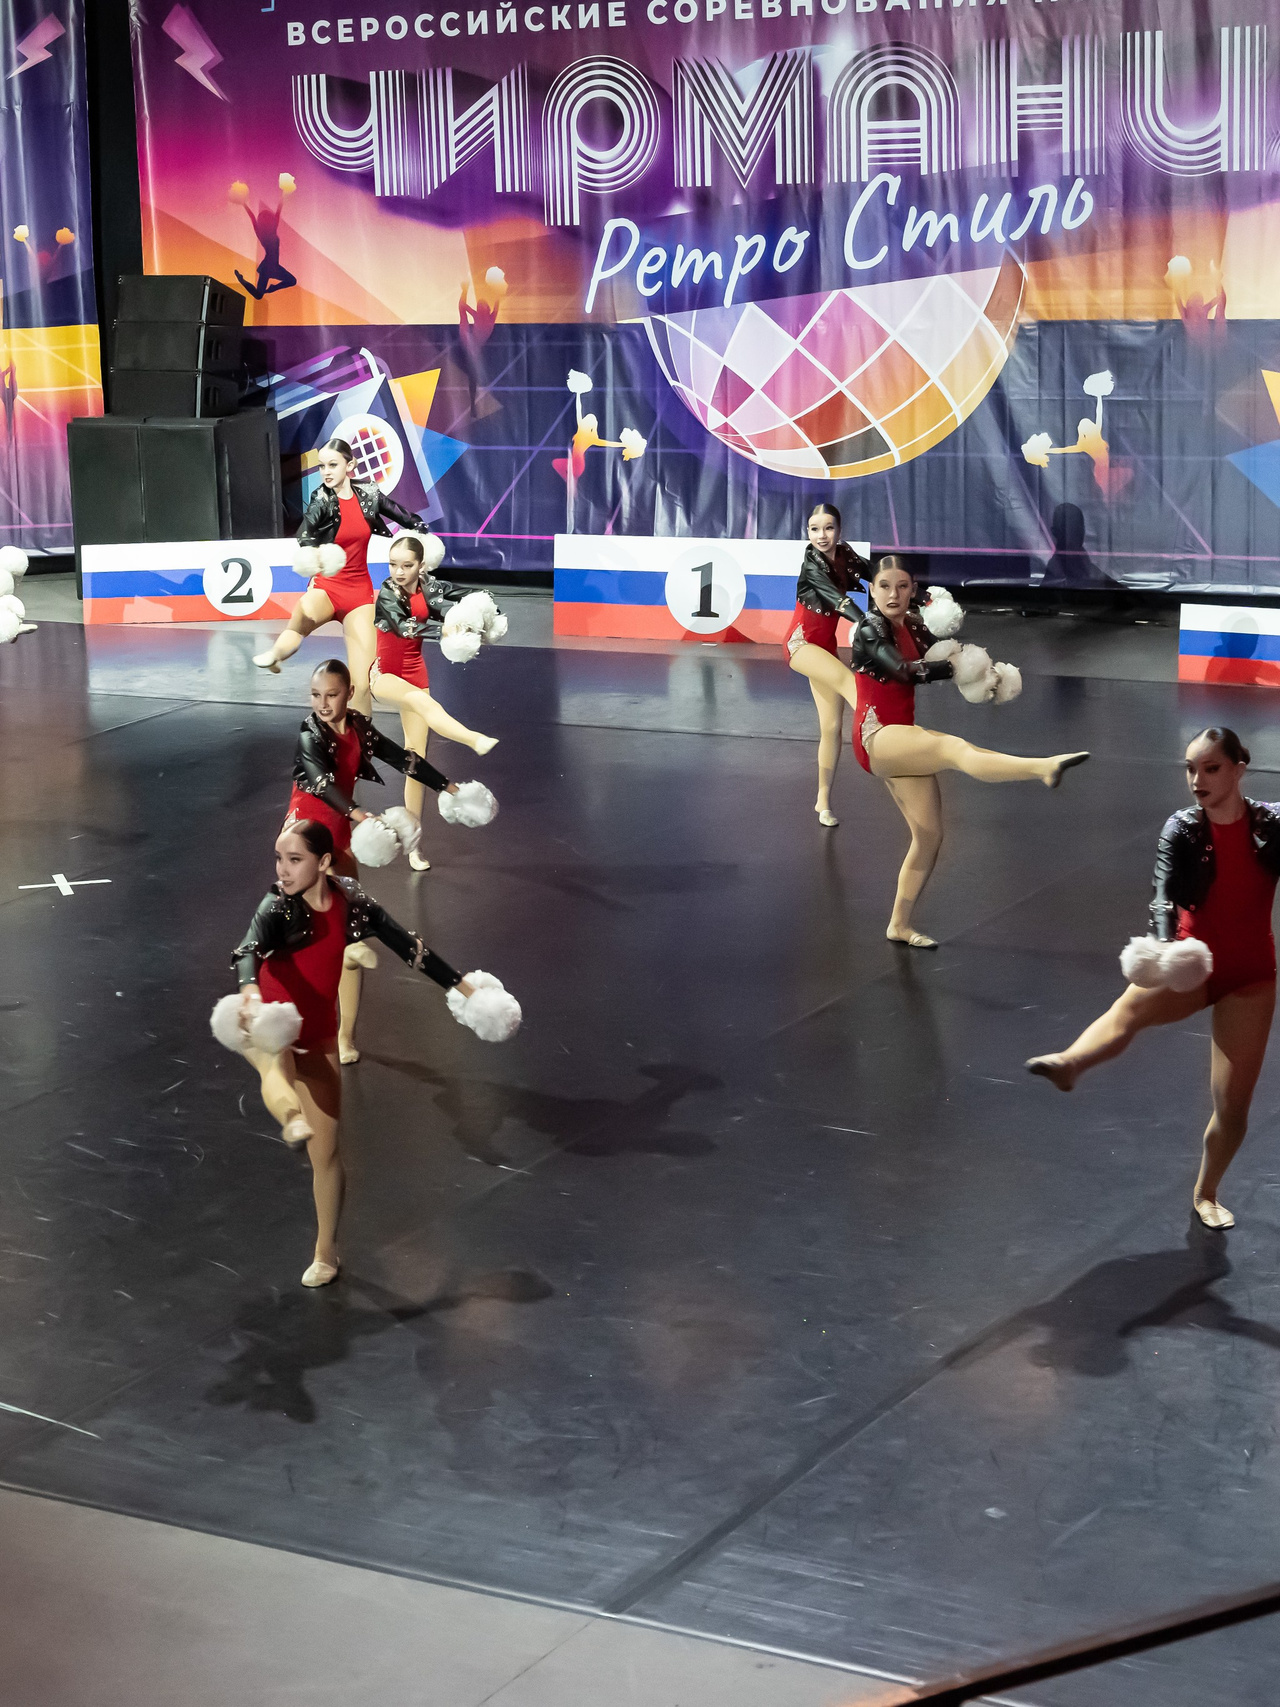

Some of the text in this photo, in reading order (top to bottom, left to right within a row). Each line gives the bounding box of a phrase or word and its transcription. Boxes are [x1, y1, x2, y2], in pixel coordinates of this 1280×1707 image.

[287, 0, 1008, 46] ВСЕРОССИЙСКИЕ СОРЕВНОВ
[291, 24, 1270, 226] ЧИРМАНИ
[584, 172, 1095, 314] Ретро Стиль
[220, 557, 255, 604] 2
[690, 561, 720, 618] 1
